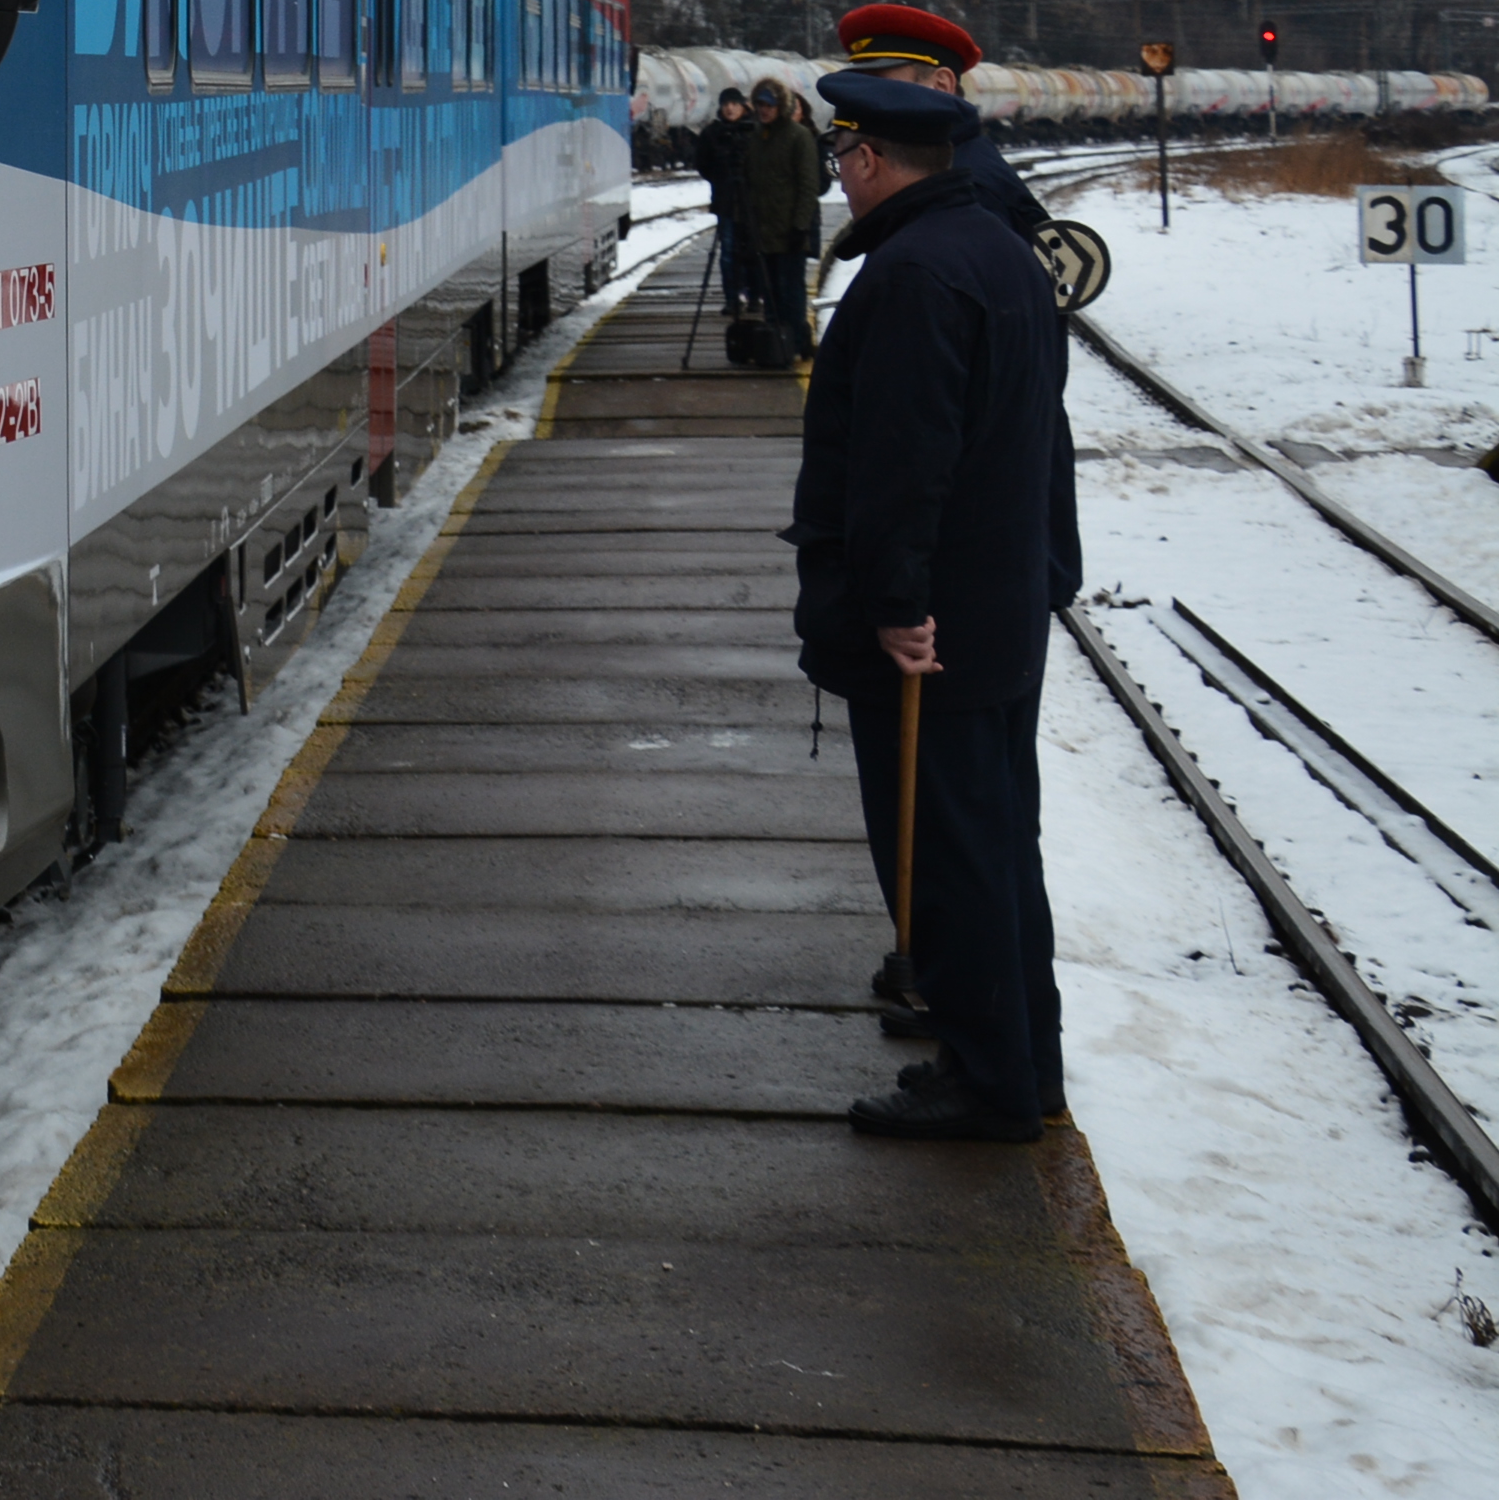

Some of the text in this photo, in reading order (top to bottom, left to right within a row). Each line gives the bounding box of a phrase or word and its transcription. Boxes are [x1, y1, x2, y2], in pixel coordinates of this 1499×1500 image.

[74, 102, 152, 265] ГОРИОЧ
[156, 99, 201, 176] УСПЕЊЕ
[1368, 195, 1454, 256] 30
[9, 264, 55, 327] 073-5
[157, 166, 299, 459] ЗОЧИШТЕ
[73, 296, 152, 512] БИНАЧ
